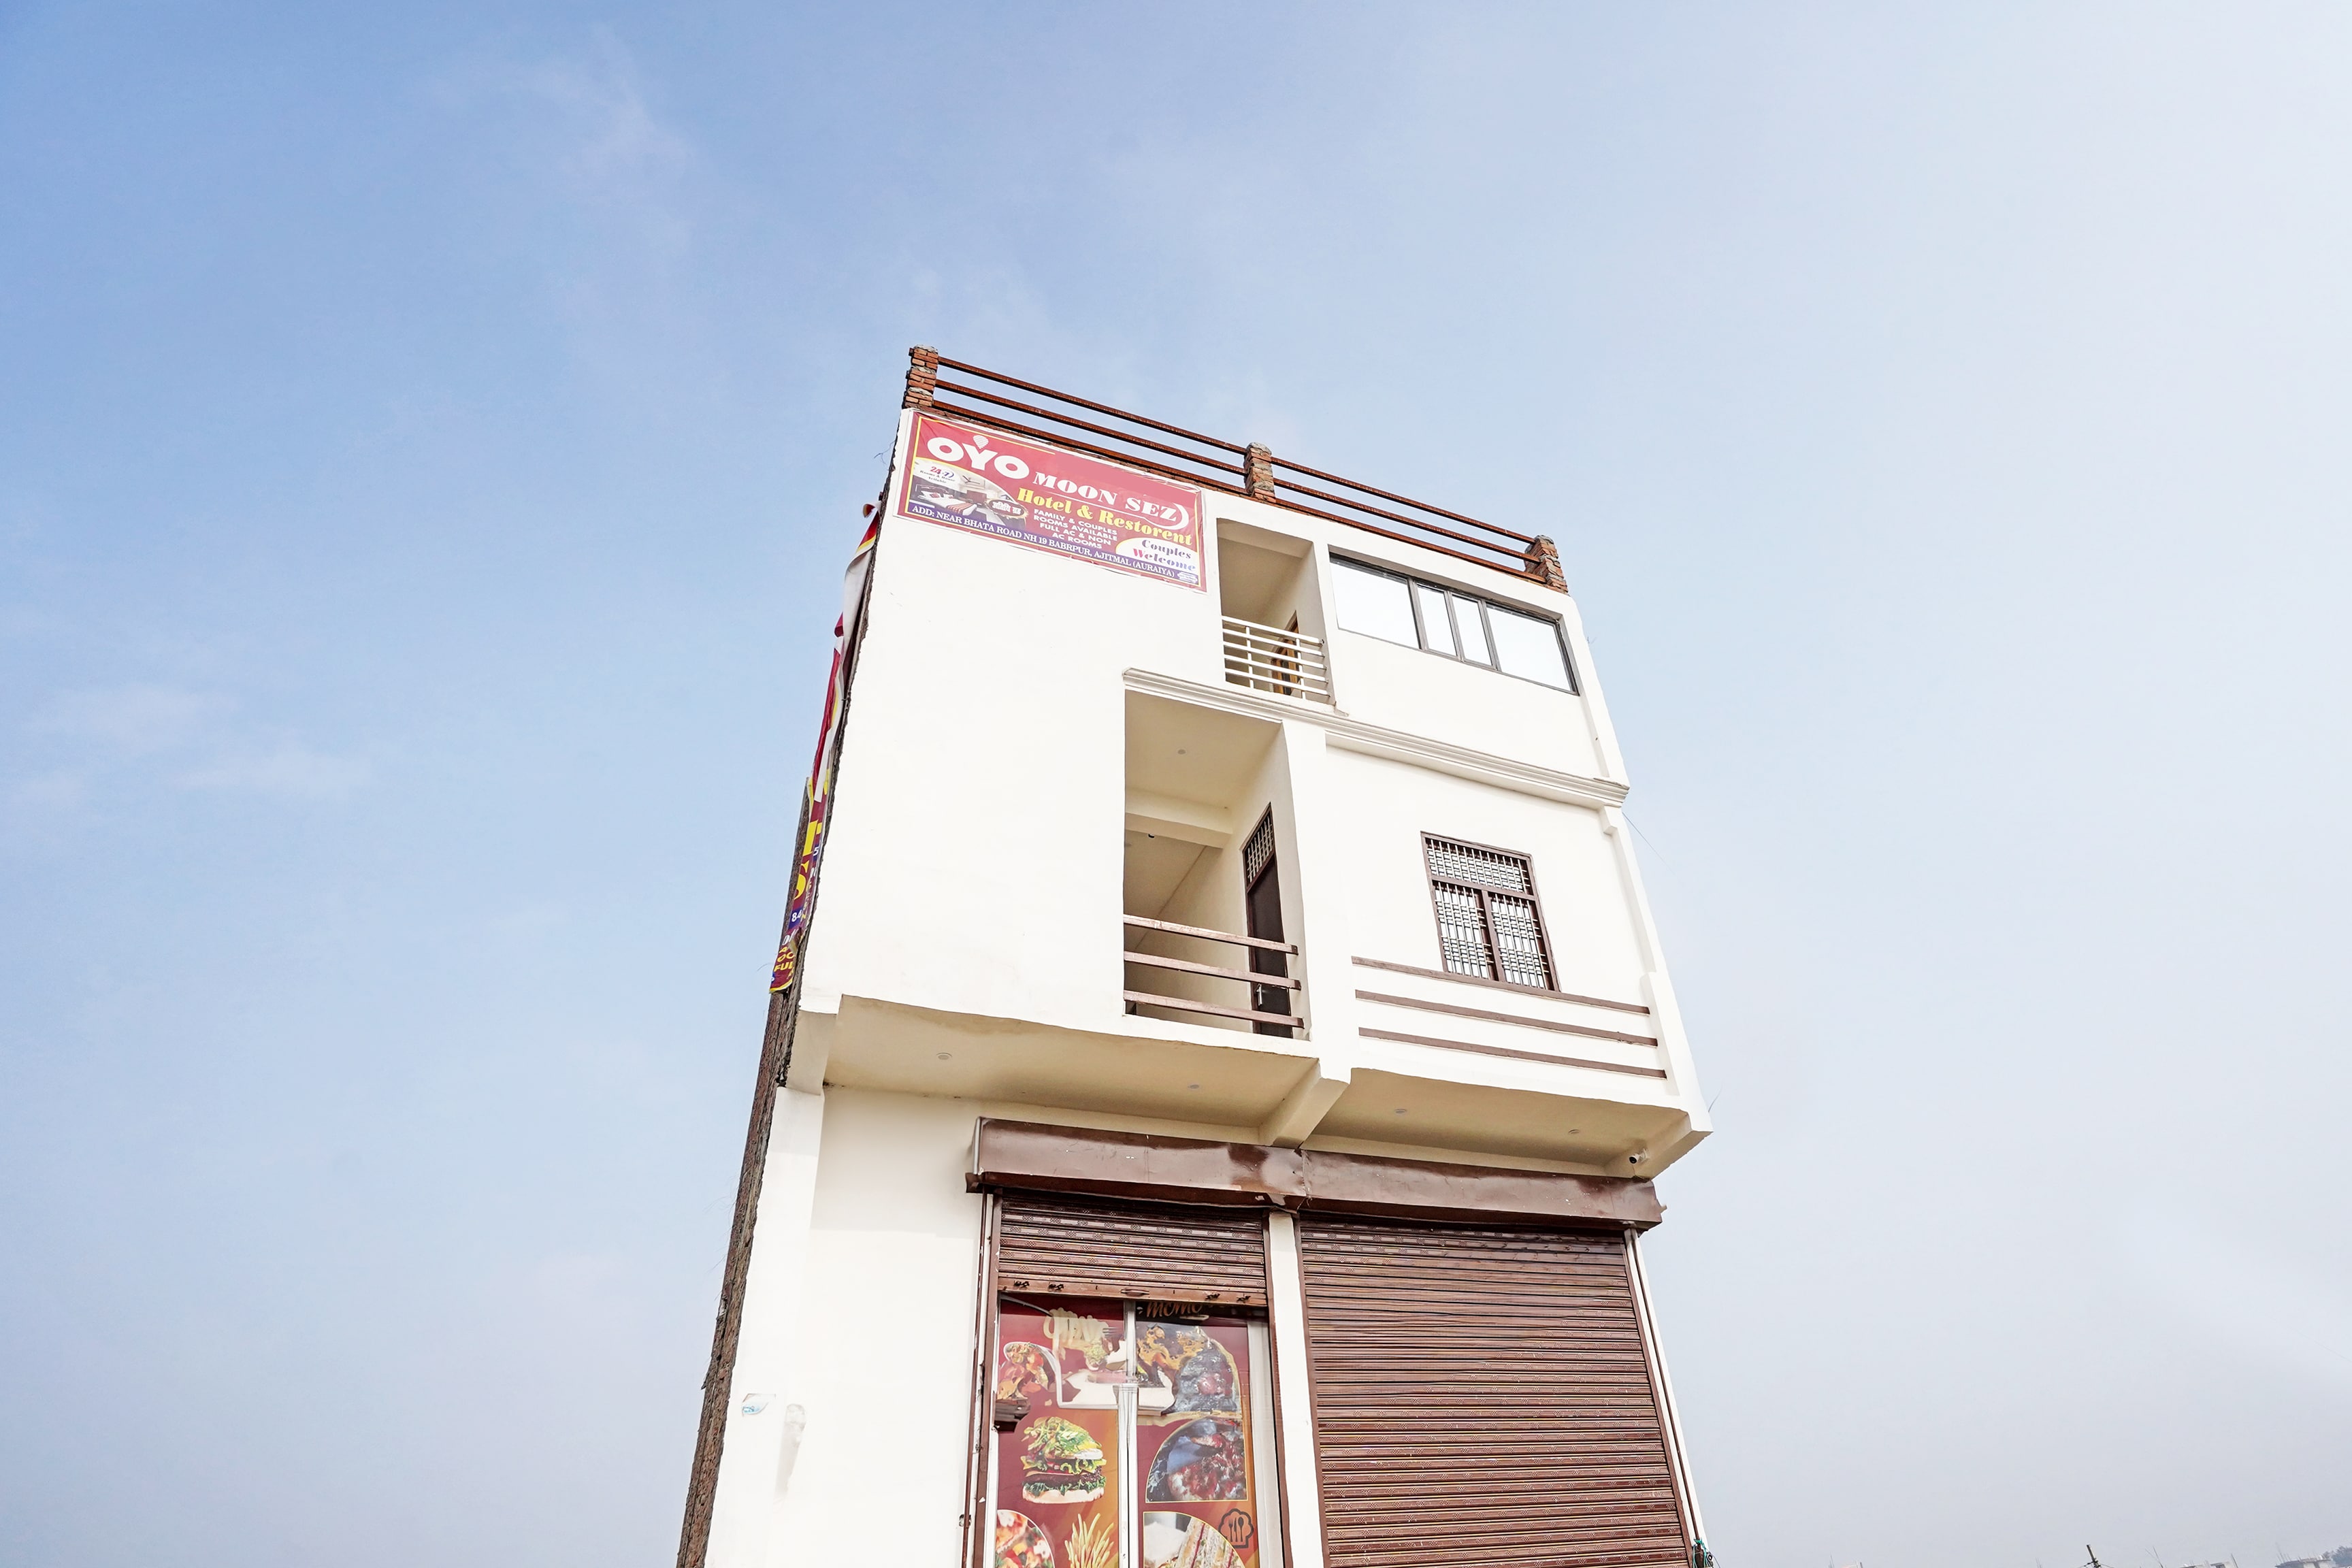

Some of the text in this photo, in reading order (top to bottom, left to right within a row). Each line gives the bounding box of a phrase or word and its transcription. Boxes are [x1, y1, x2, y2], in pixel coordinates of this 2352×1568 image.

[926, 436, 1030, 480] OYO
[1032, 471, 1178, 522] MOON SEZ
[1017, 487, 1192, 545] Hotel & Restorent
[1033, 515, 1117, 541] ROOMS AVAILABLE
[1034, 508, 1066, 521] FAMILY
[1078, 521, 1117, 535] COUPLES
[912, 506, 935, 517] ADD:
[936, 512, 962, 524] NEAR
[964, 518, 996, 532] BHATA
[996, 525, 1022, 538] ROAD
[1024, 533, 1037, 542] NH
[1049, 540, 1093, 557] BABRPUR,
[1094, 551, 1132, 565] AJITMAL
[1132, 561, 1175, 577] (AURAIYA)
[1040, 523, 1060, 532] FULL
[1088, 535, 1111, 545] NON
[1068, 536, 1102, 549] ROOMS
[1132, 548, 1196, 571] Welcome
[1142, 539, 1192, 559] Couples
